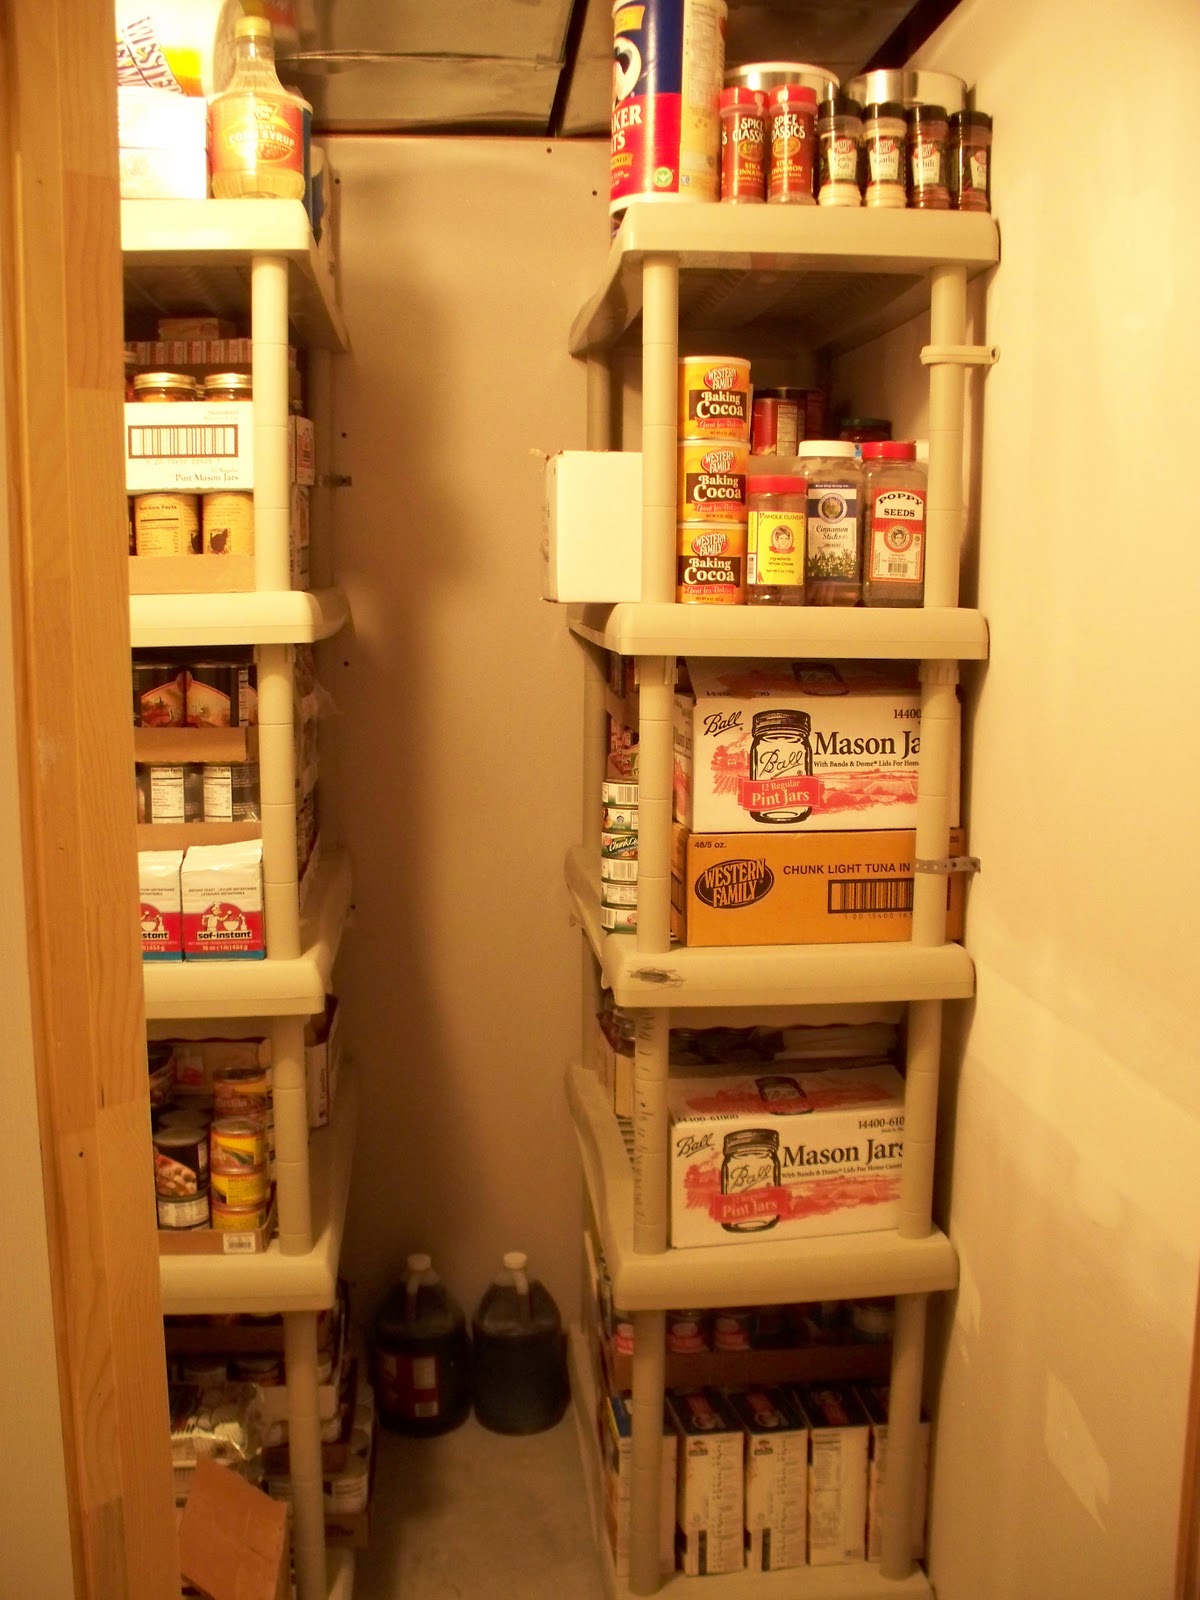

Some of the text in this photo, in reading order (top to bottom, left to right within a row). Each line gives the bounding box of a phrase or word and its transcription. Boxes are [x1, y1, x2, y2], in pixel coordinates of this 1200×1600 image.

[774, 114, 798, 128] SPICE
[262, 130, 295, 146] SYRUP
[916, 159, 936, 169] Chili
[708, 367, 737, 380] WESTERN
[712, 377, 733, 390] FAMILY
[701, 391, 741, 405] Baking
[696, 400, 744, 419] Cocoa
[705, 450, 734, 464] WESTERN
[709, 460, 731, 473] FAMILY
[175, 473, 239, 483] Pint Mason Jars
[698, 474, 739, 488] Baking
[693, 484, 741, 502] Cocoa
[878, 493, 923, 506] POPPY
[883, 508, 915, 518] SEEDS
[816, 525, 849, 534] Cinnamon
[822, 532, 842, 541] Sticks
[696, 533, 726, 547] WESTERN
[700, 543, 723, 556] FAMILY
[689, 557, 731, 570] Baking
[684, 566, 735, 585] Cocoa
[703, 710, 743, 737] Ball
[814, 731, 920, 760] Mason Ja
[759, 749, 804, 778] Ball
[813, 760, 829, 768] With
[830, 760, 848, 768] Bands
[771, 780, 801, 793] Regular
[751, 789, 810, 806] Pint Jars
[694, 841, 713, 849] 48/5
[705, 858, 766, 889] WESTERN
[783, 863, 911, 875] CHUNK LIGHT TUNA IN
[713, 879, 757, 908] FAMILY
[198, 930, 251, 940] saf-instant
[858, 1116, 905, 1130] 14400-610
[676, 1132, 715, 1158] Ball
[782, 1138, 904, 1168] Mason Jars
[782, 1171, 796, 1179] With
[797, 1170, 815, 1178] Bands
[867, 1163, 884, 1171] Home
[730, 1165, 772, 1192] Ball
[723, 1200, 778, 1218] Pint Jars
